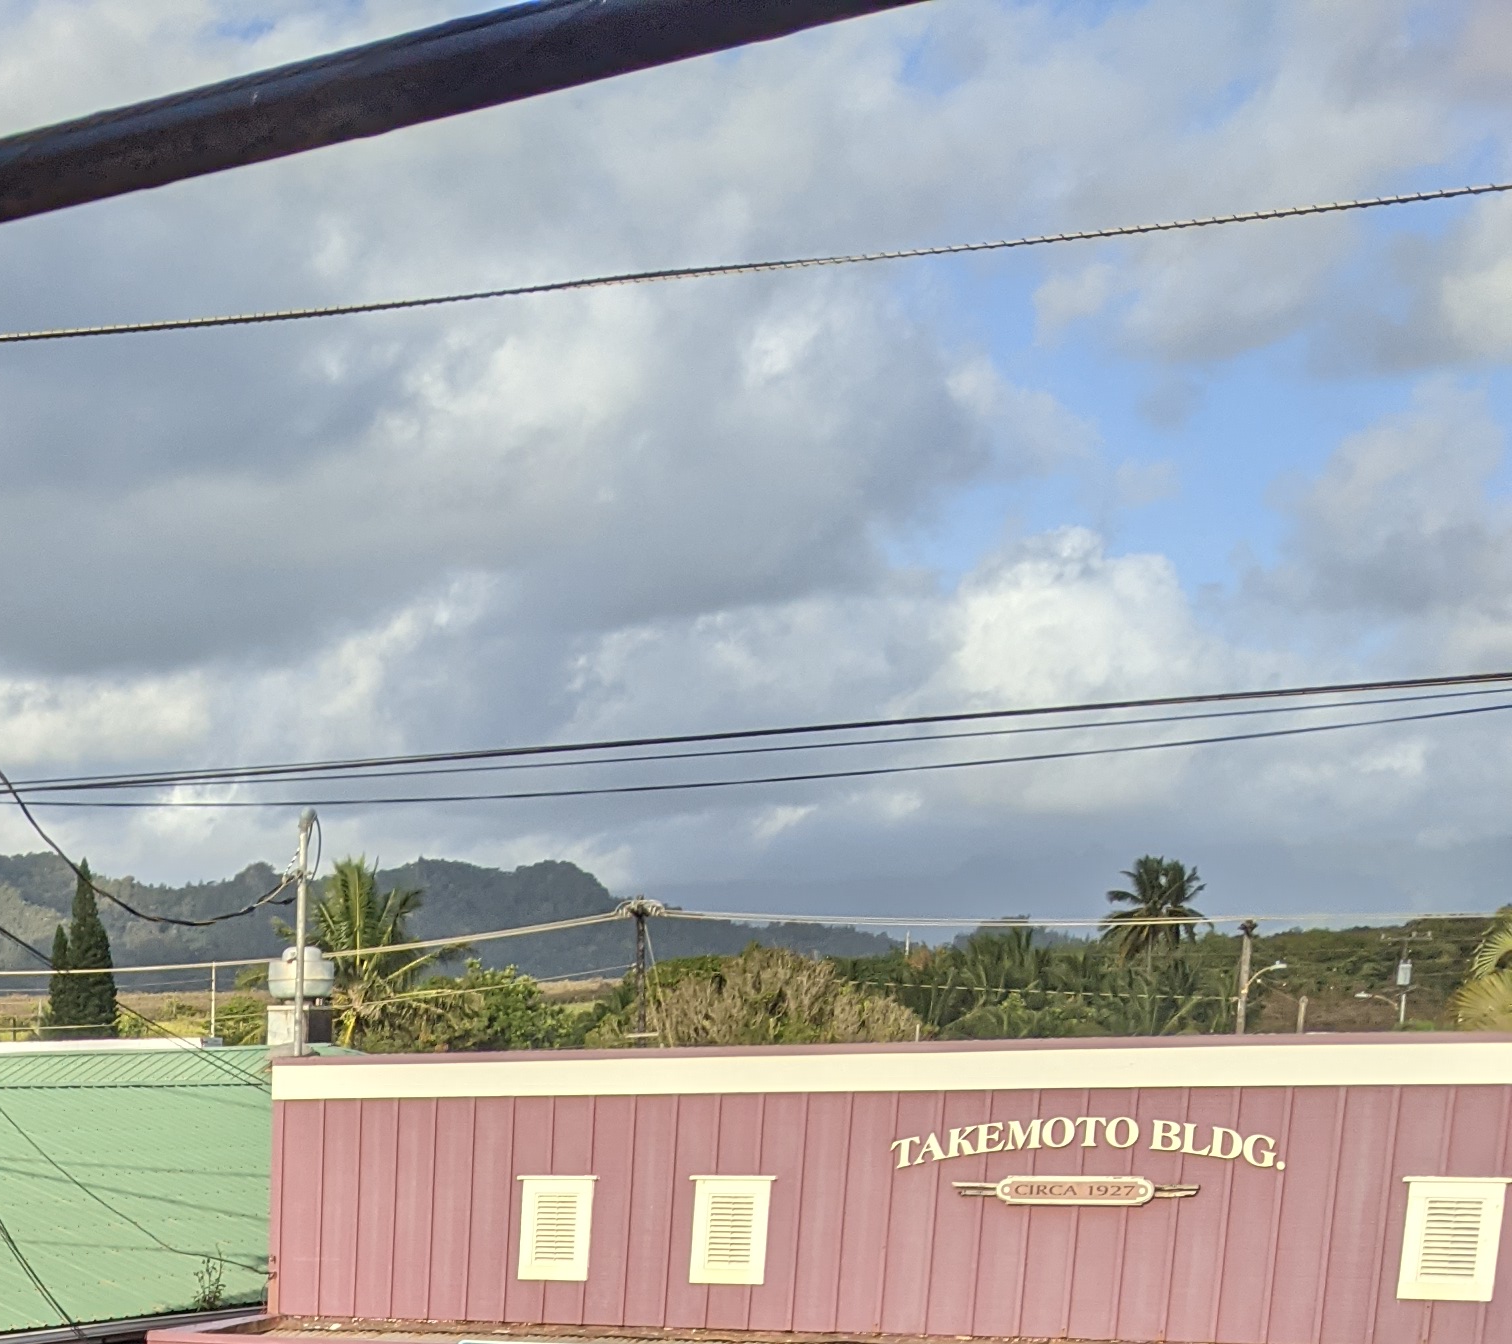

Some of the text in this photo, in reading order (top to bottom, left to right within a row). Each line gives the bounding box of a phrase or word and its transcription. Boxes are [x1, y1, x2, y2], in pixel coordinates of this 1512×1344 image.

[890, 1116, 1286, 1171] TAKEMOTO BLDG.
[1014, 1184, 1136, 1197] CIRCA 1927
